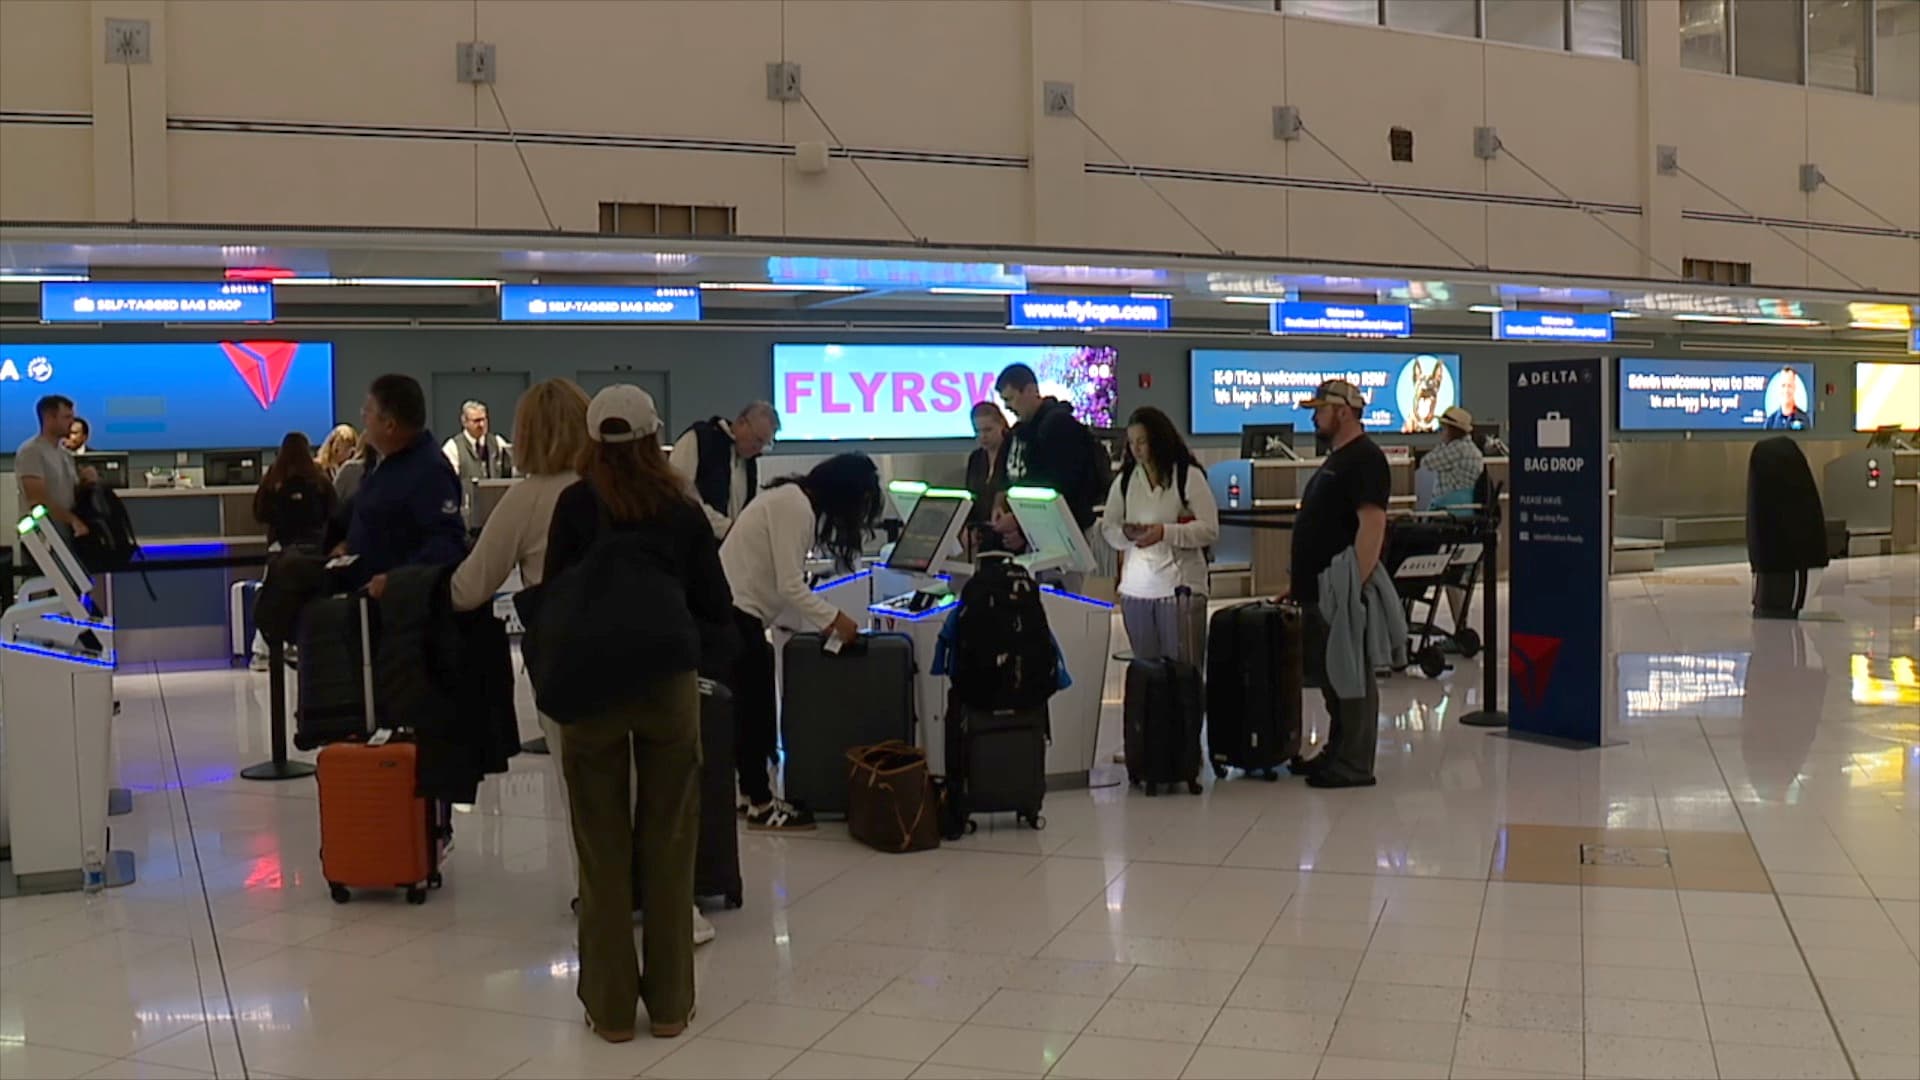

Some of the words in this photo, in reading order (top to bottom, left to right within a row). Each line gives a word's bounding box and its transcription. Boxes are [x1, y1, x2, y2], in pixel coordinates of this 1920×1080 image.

[96, 298, 179, 312] SELF-TAGGED
[180, 299, 206, 312] BAG
[207, 299, 243, 312] DROP
[548, 301, 619, 313] SELF-TAGGED
[620, 302, 643, 313] BAG
[644, 302, 674, 313] DROP
[1261, 369, 1322, 387] welcomes
[1346, 370, 1361, 387] to
[1361, 370, 1387, 387] RSW
[1530, 369, 1579, 386] DELTA
[1711, 376, 1731, 392] you
[1731, 375, 1743, 391] to
[1232, 385, 1259, 410] hope
[1259, 385, 1273, 405] to
[1274, 389, 1290, 406] see
[1523, 456, 1549, 473] BAG
[1550, 456, 1585, 473] DROP
